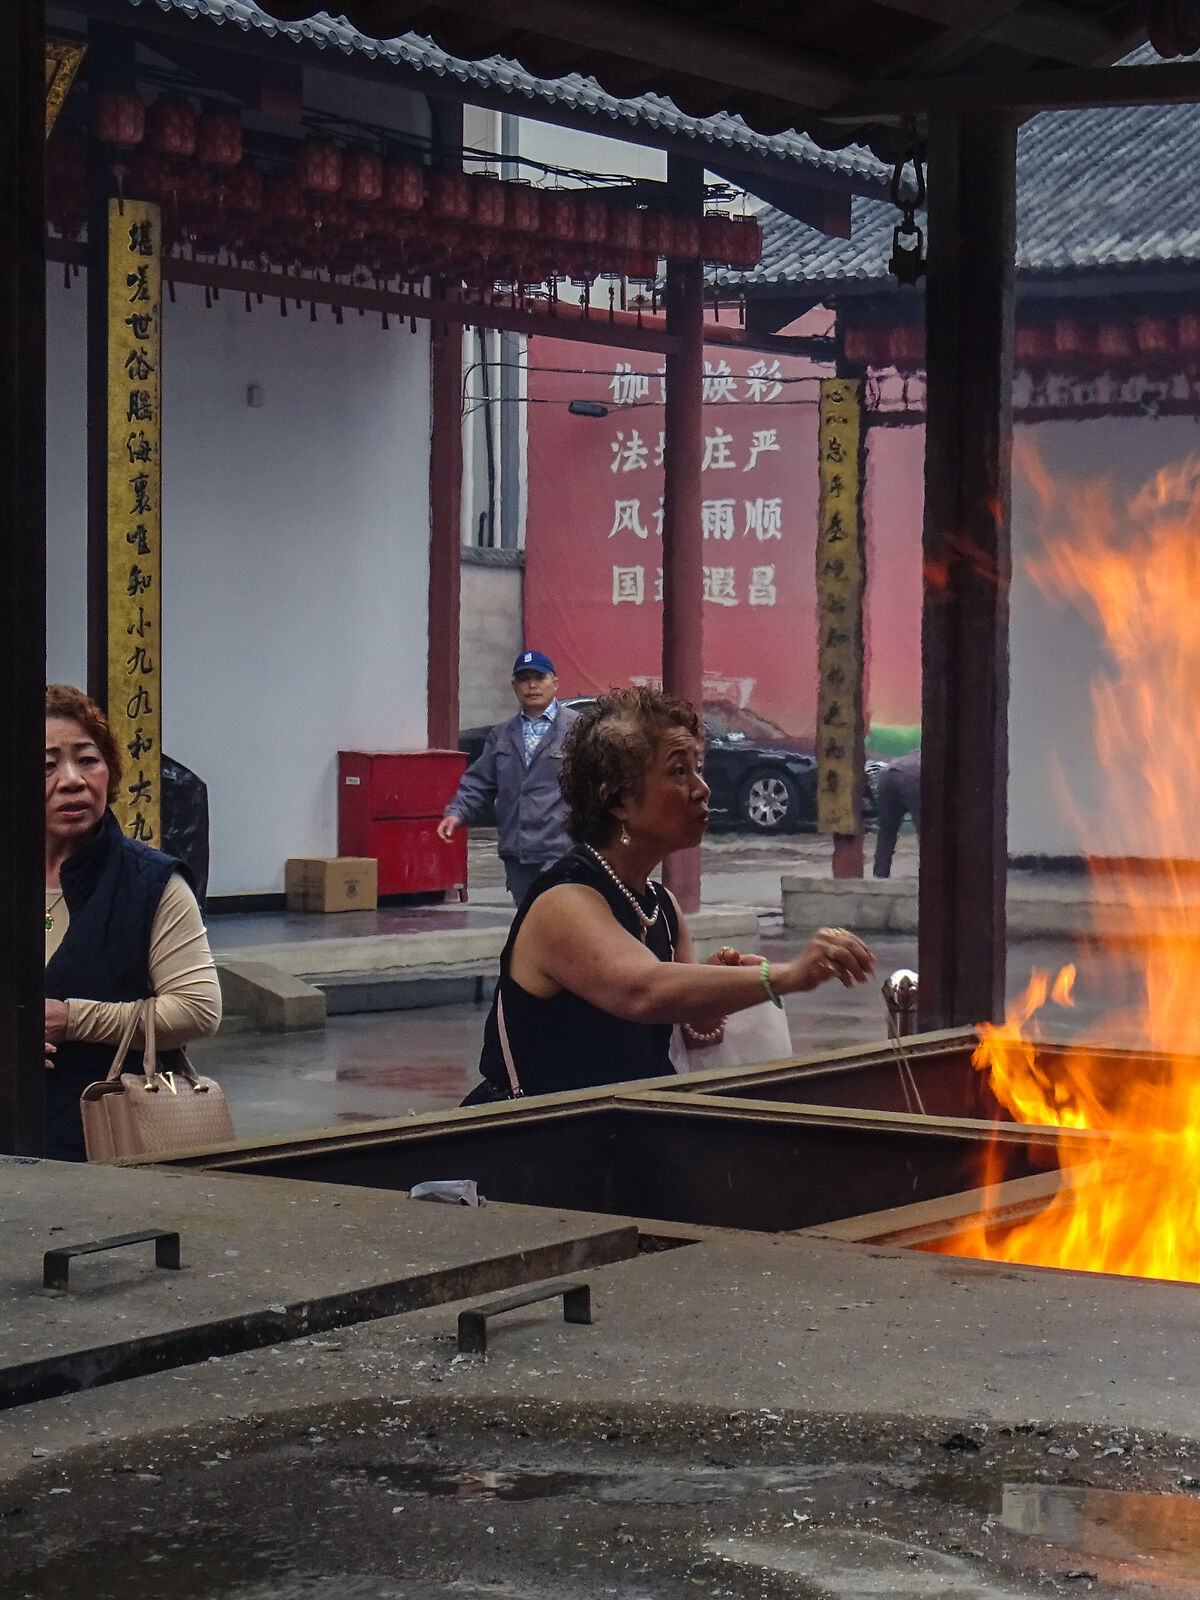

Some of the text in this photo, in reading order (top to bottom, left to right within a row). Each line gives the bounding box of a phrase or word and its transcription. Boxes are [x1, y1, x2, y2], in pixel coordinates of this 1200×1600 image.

[608, 358, 783, 405] 伽焕彩
[610, 428, 780, 473] 法庄严
[608, 497, 782, 542] 风雨顺
[611, 563, 778, 607] 国遐昌
